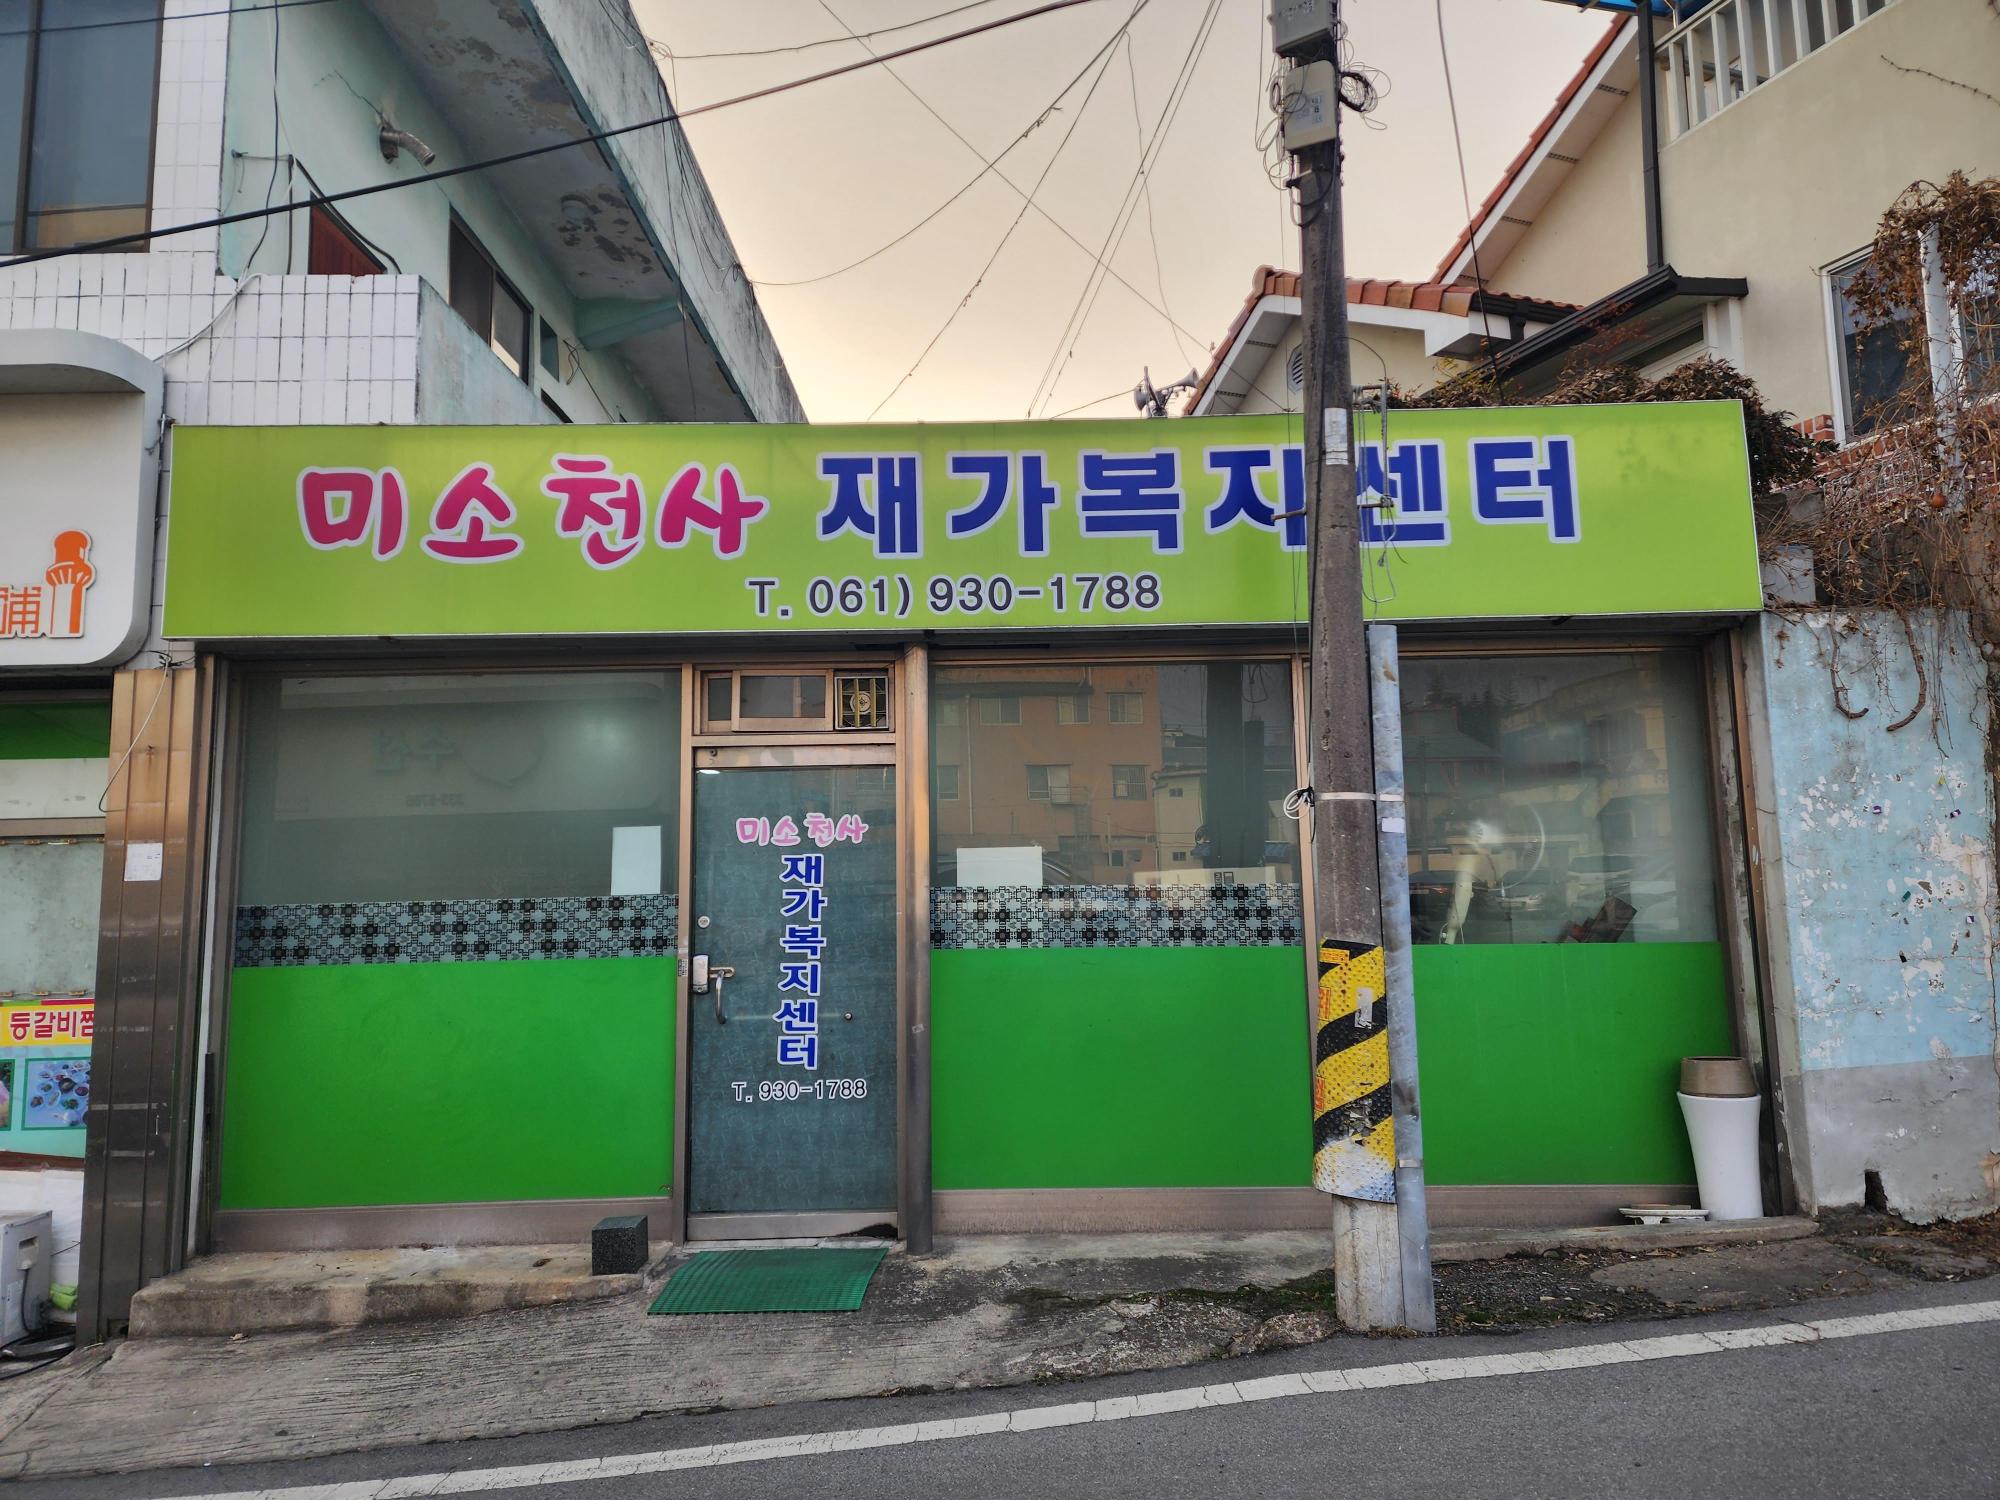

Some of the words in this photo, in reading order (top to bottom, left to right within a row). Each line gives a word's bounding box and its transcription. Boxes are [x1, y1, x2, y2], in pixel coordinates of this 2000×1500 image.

[817, 437, 1582, 557] 재가복지센터
[747, 577, 791, 619] T.
[808, 575, 911, 619] 061)
[927, 572, 1162, 616] 930-1788
[774, 854, 827, 1070] 재가복지센터
[731, 1081, 753, 1103] T.
[758, 1078, 868, 1101] 930-1788
